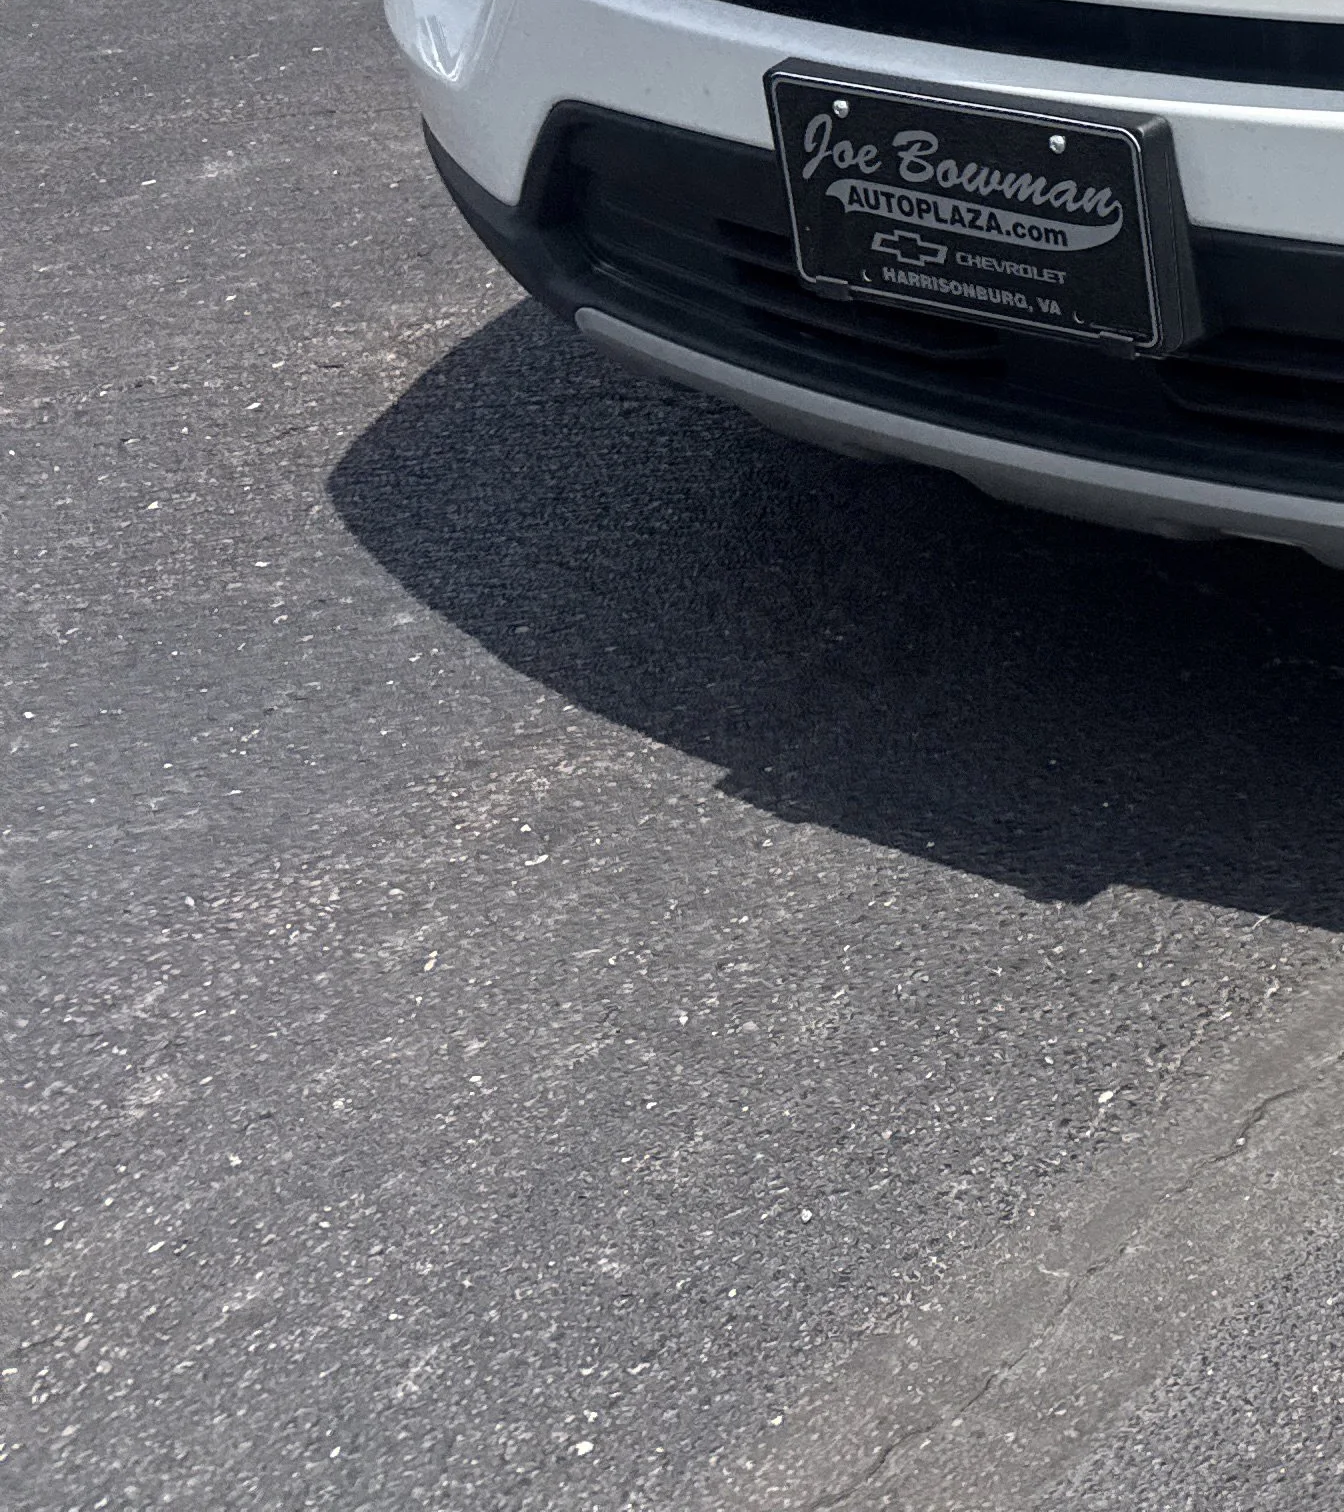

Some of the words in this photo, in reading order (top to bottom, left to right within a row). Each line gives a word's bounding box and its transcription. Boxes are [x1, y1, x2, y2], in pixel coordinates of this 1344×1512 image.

[802, 113, 883, 180] Joe
[892, 130, 1120, 218] Bowman
[847, 184, 1070, 248] AUTOPLAZA.com
[883, 266, 1033, 312] HARRISONBURG,
[1036, 296, 1063, 316] VA
[954, 251, 1067, 285] CHEVROLET
